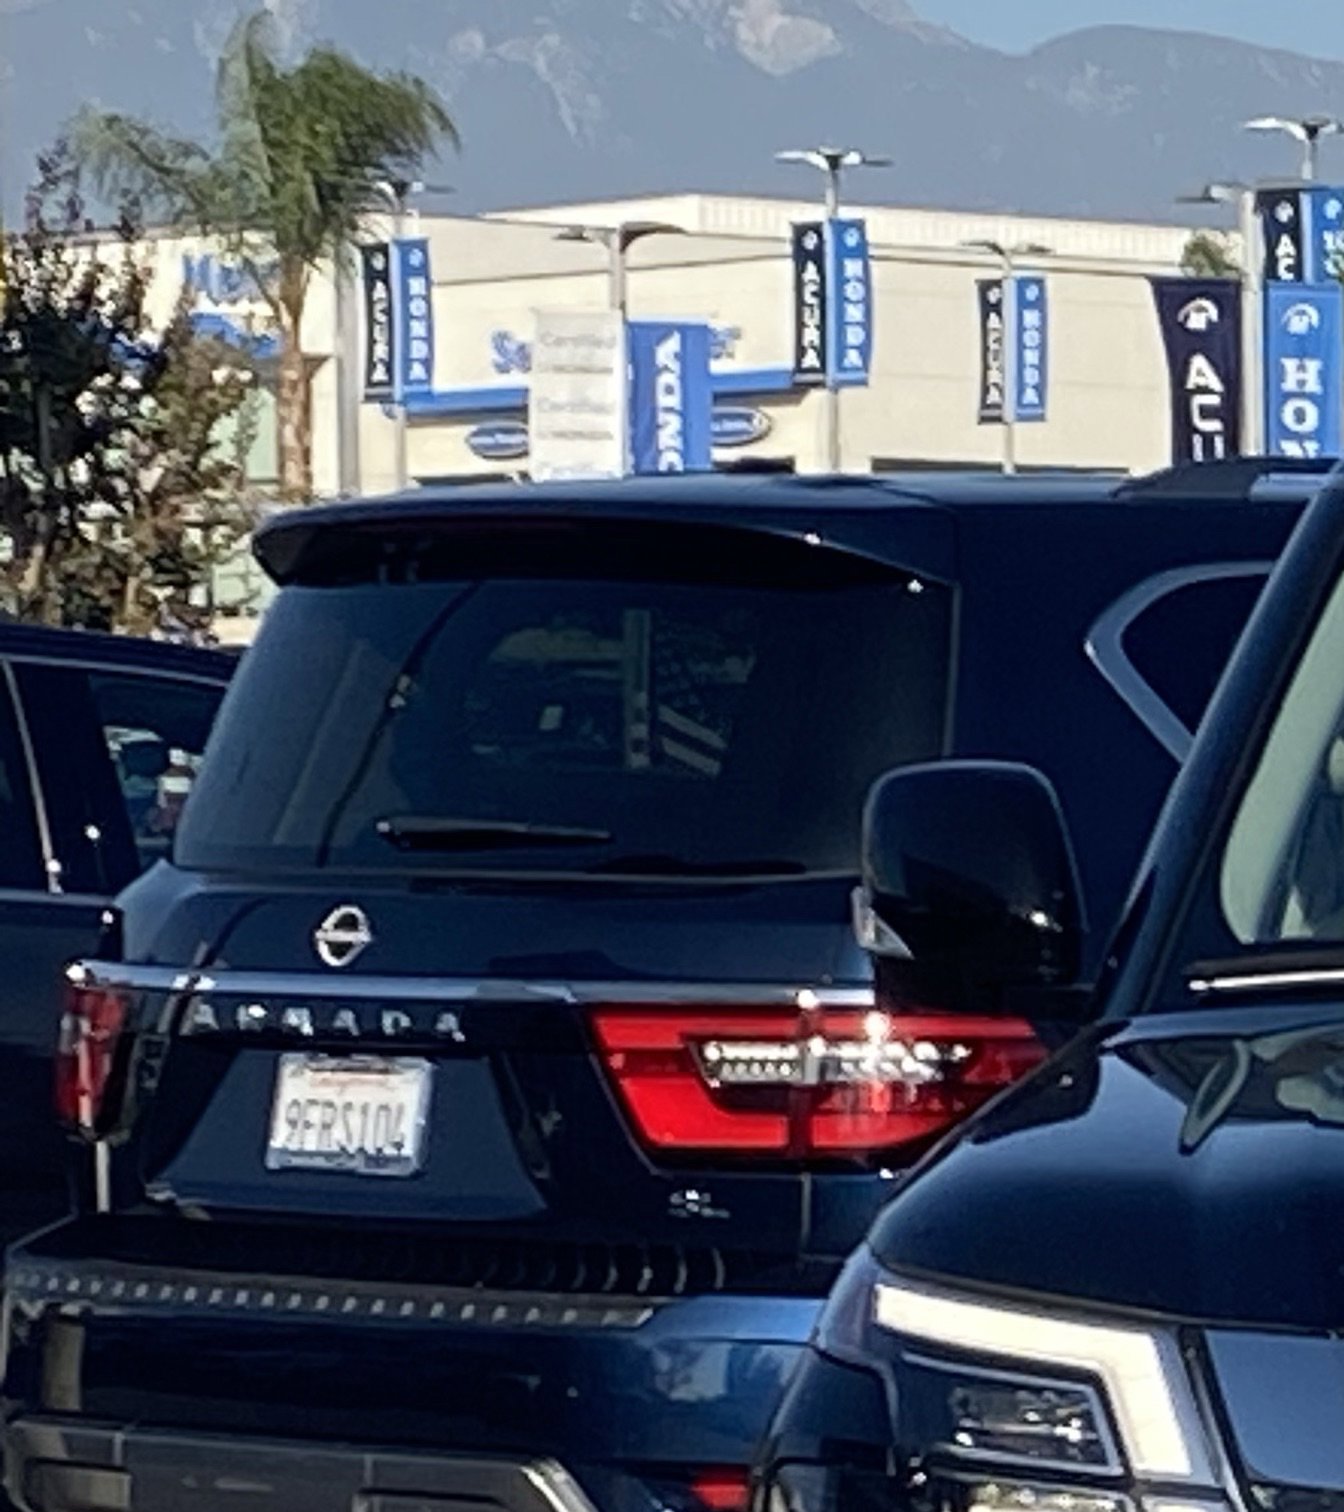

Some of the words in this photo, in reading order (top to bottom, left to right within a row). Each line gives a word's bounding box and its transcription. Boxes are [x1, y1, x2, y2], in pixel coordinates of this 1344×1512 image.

[370, 280, 390, 383] ACURA
[409, 277, 429, 381] HONDA
[801, 260, 821, 369] ACURA
[843, 258, 866, 369] HONDA
[986, 311, 1003, 405] ACURA
[1022, 309, 1041, 405] HONDA
[191, 1003, 467, 1042] ARMADA
